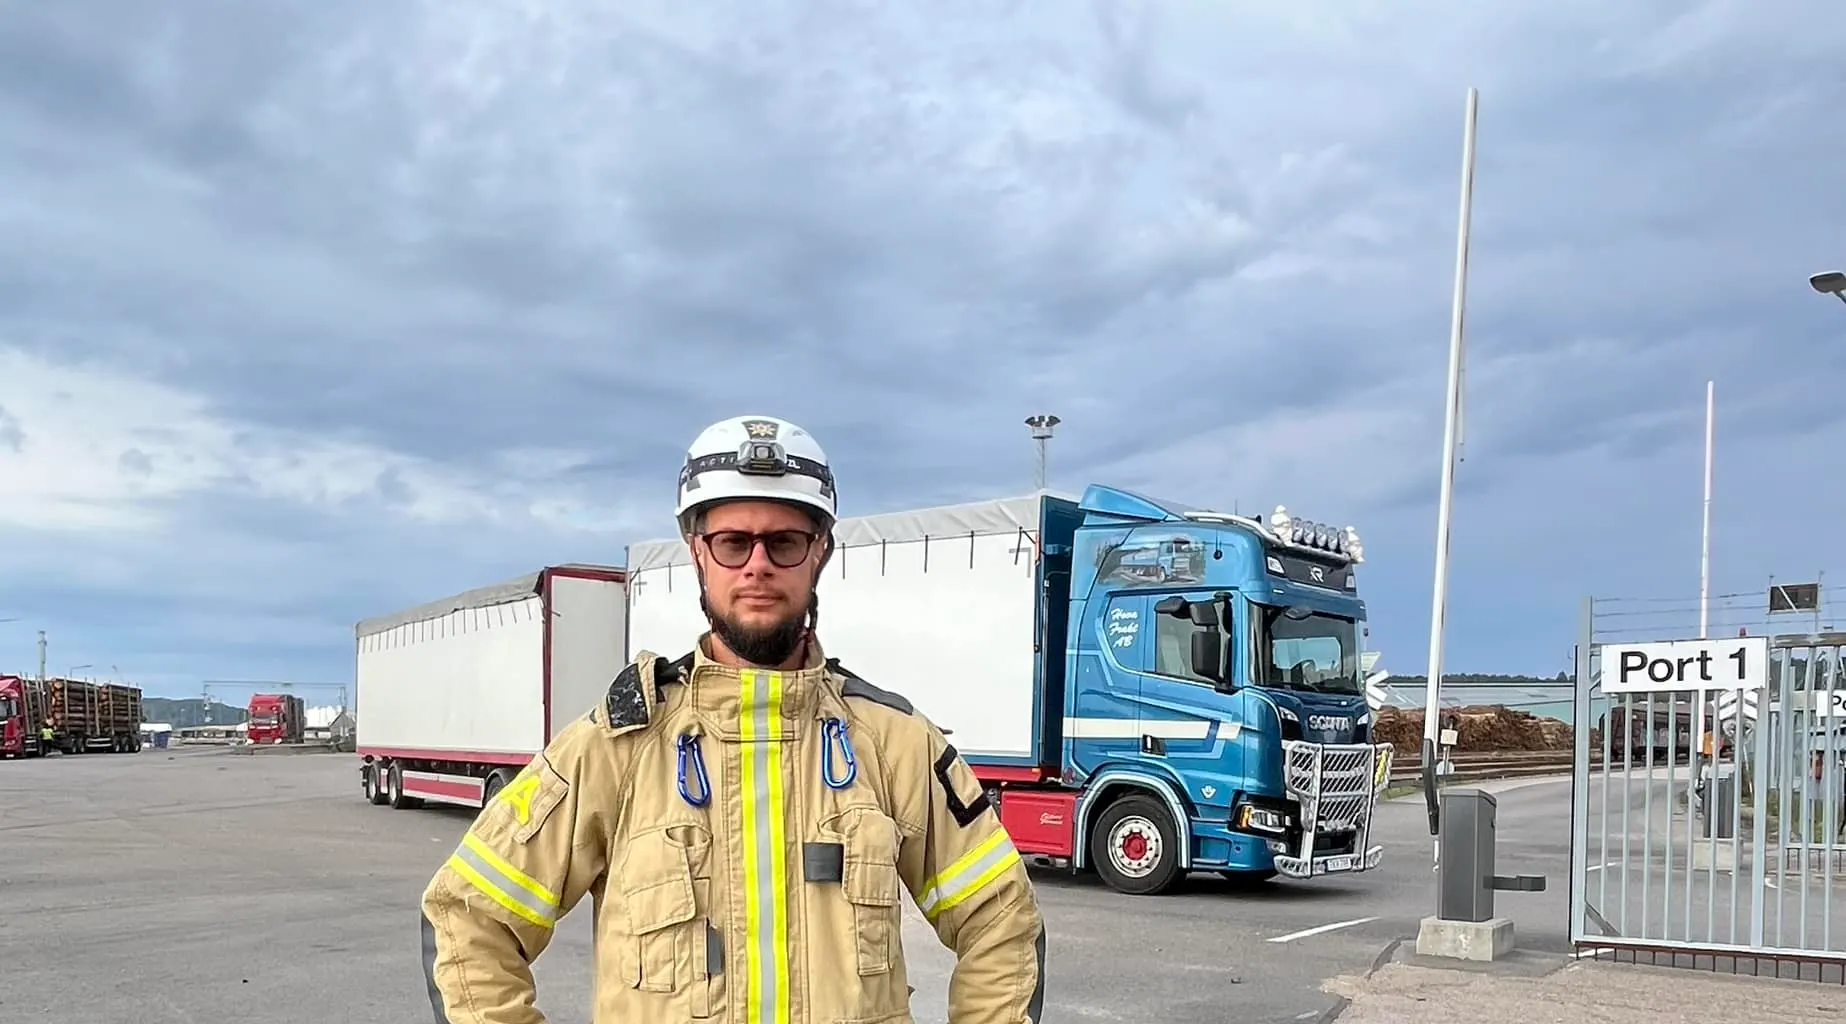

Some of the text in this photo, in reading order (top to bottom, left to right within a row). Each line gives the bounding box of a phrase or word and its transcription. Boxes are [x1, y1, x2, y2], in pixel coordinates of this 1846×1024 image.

[700, 456, 736, 468] ACTI
[1619, 647, 1747, 683] Port 1
[1309, 714, 1351, 731] SCANIA
